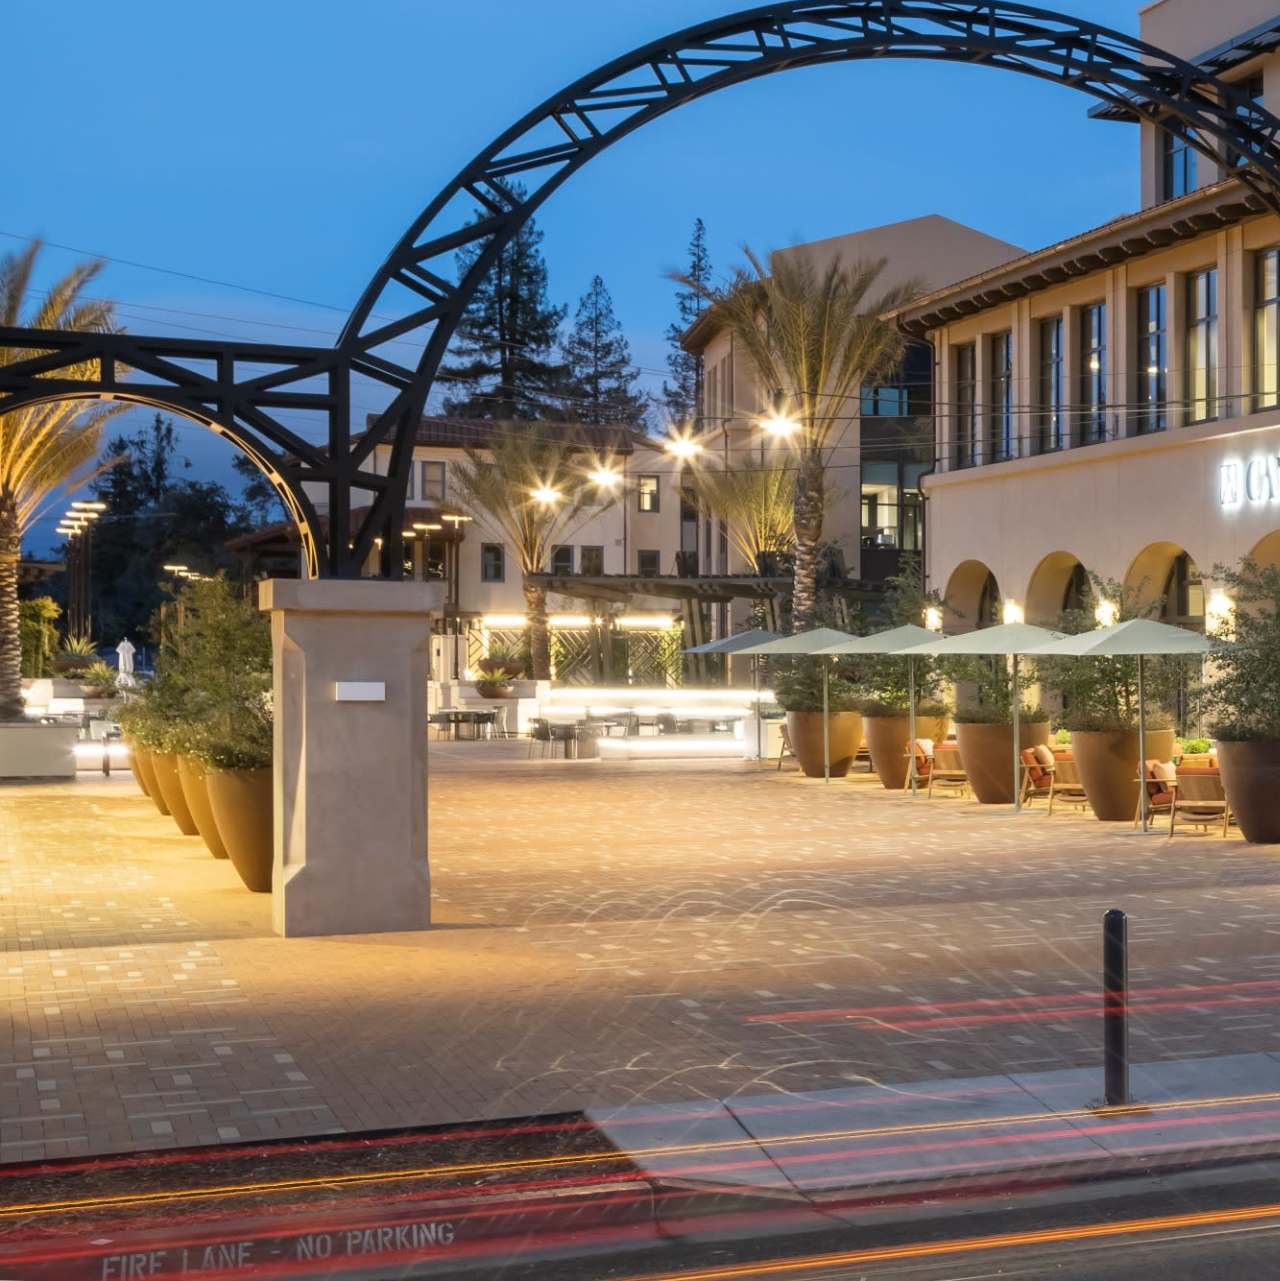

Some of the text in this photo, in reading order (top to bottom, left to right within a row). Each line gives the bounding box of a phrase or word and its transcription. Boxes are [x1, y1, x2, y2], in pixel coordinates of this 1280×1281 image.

[102, 1251, 167, 1281] FIRE
[182, 1242, 255, 1275] LANE
[296, 1233, 332, 1261] NO
[346, 1222, 455, 1257] PARKING
